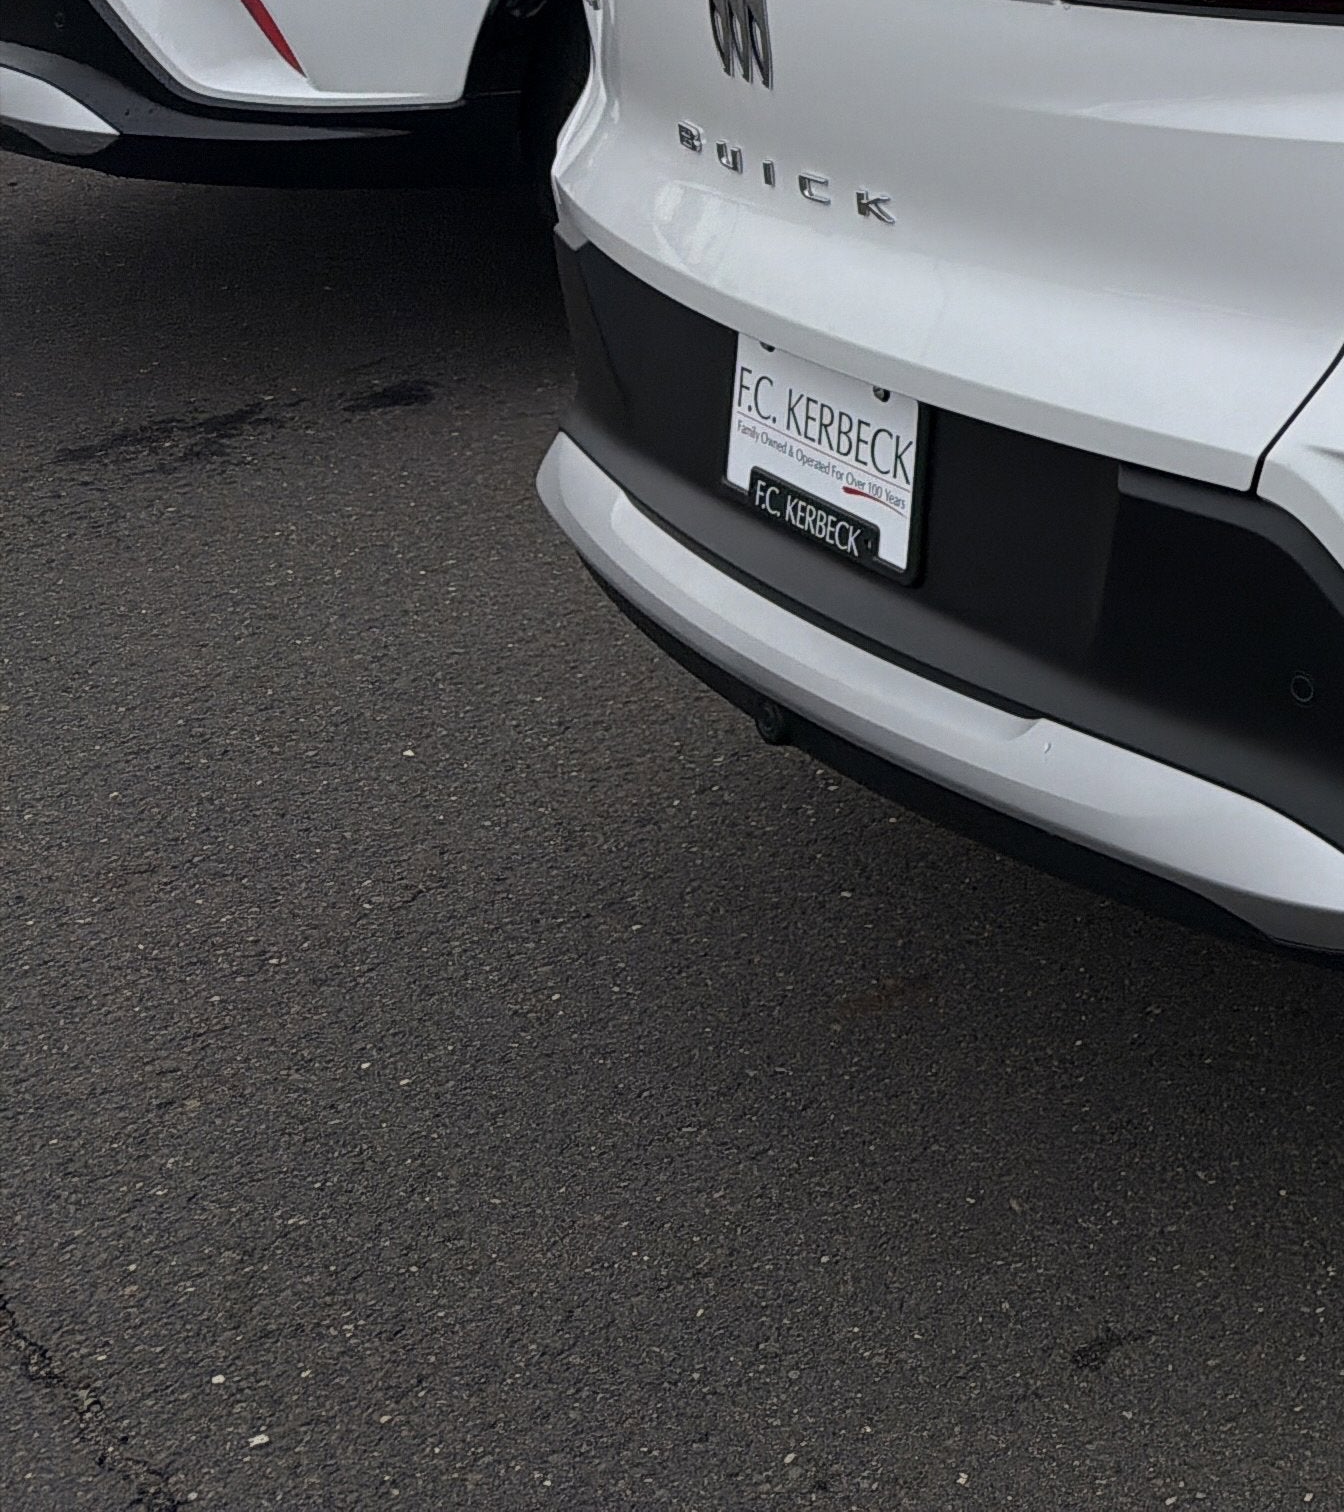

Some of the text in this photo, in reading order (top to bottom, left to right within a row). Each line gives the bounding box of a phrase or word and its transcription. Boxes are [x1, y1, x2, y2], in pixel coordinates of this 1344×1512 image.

[678, 120, 896, 225] BUICK
[737, 366, 914, 486] F.C. KERBECK
[737, 419, 906, 510] Family Owned & Operated For Over 100 Years
[755, 479, 861, 558] F.C. KERBECK
